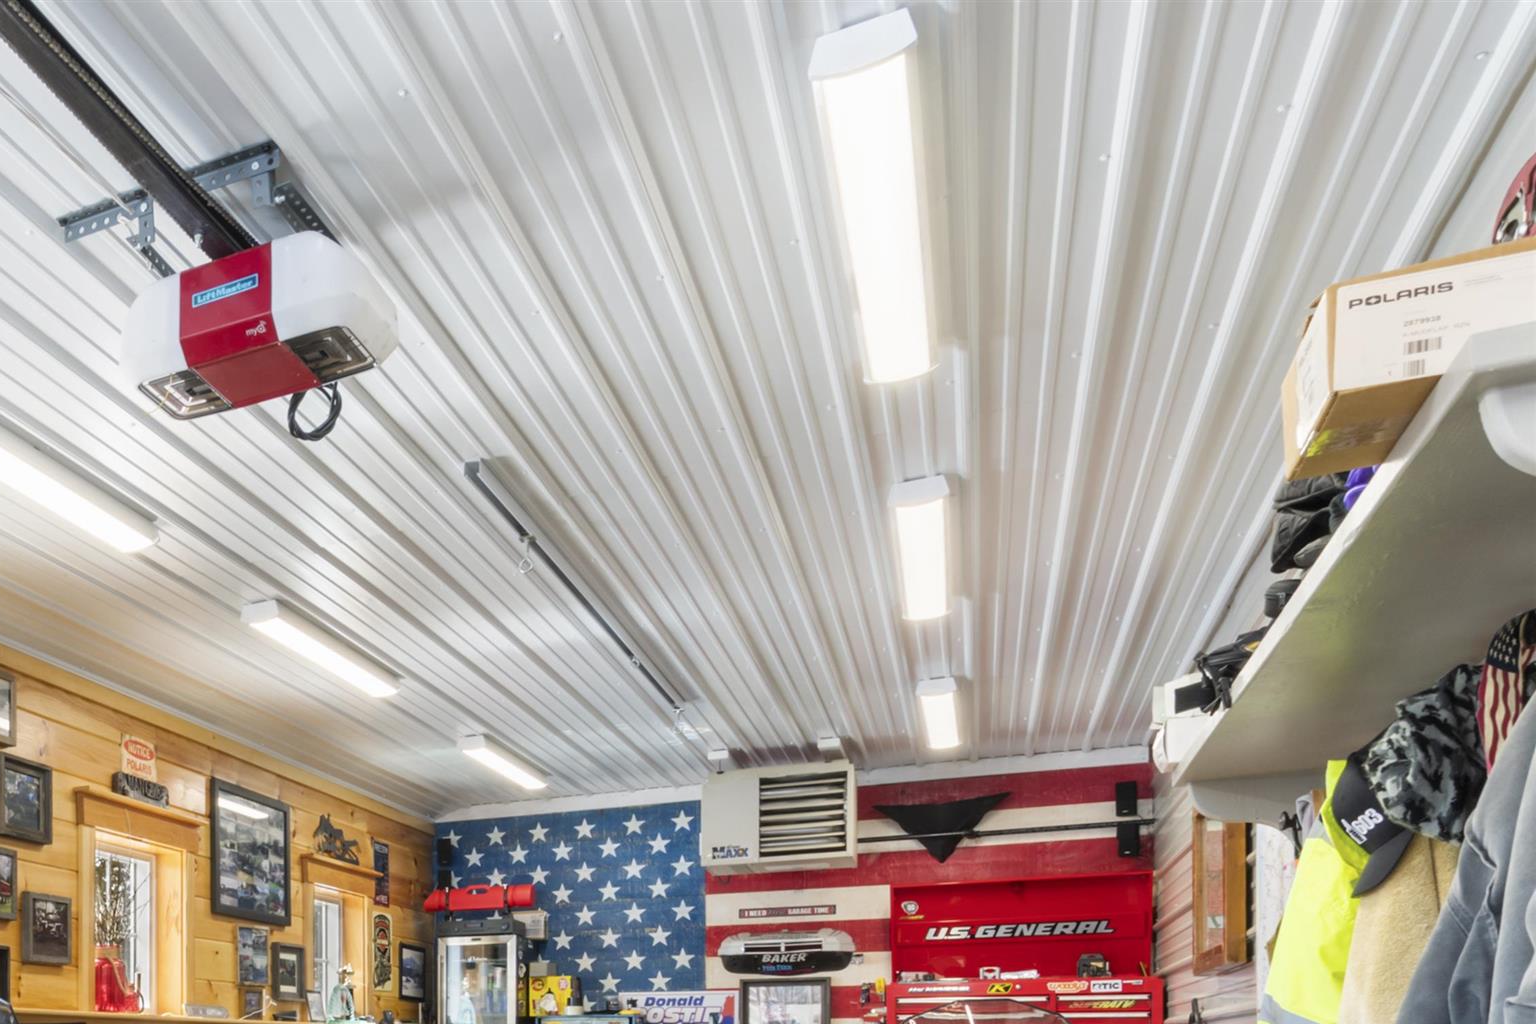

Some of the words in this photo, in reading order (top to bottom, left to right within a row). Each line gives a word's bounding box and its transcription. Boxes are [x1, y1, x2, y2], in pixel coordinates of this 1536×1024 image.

[1348, 282, 1453, 309] POLARIS
[975, 920, 1115, 939] GENERAL
[762, 953, 807, 963] BAKER
[645, 996, 704, 1007] Donald
